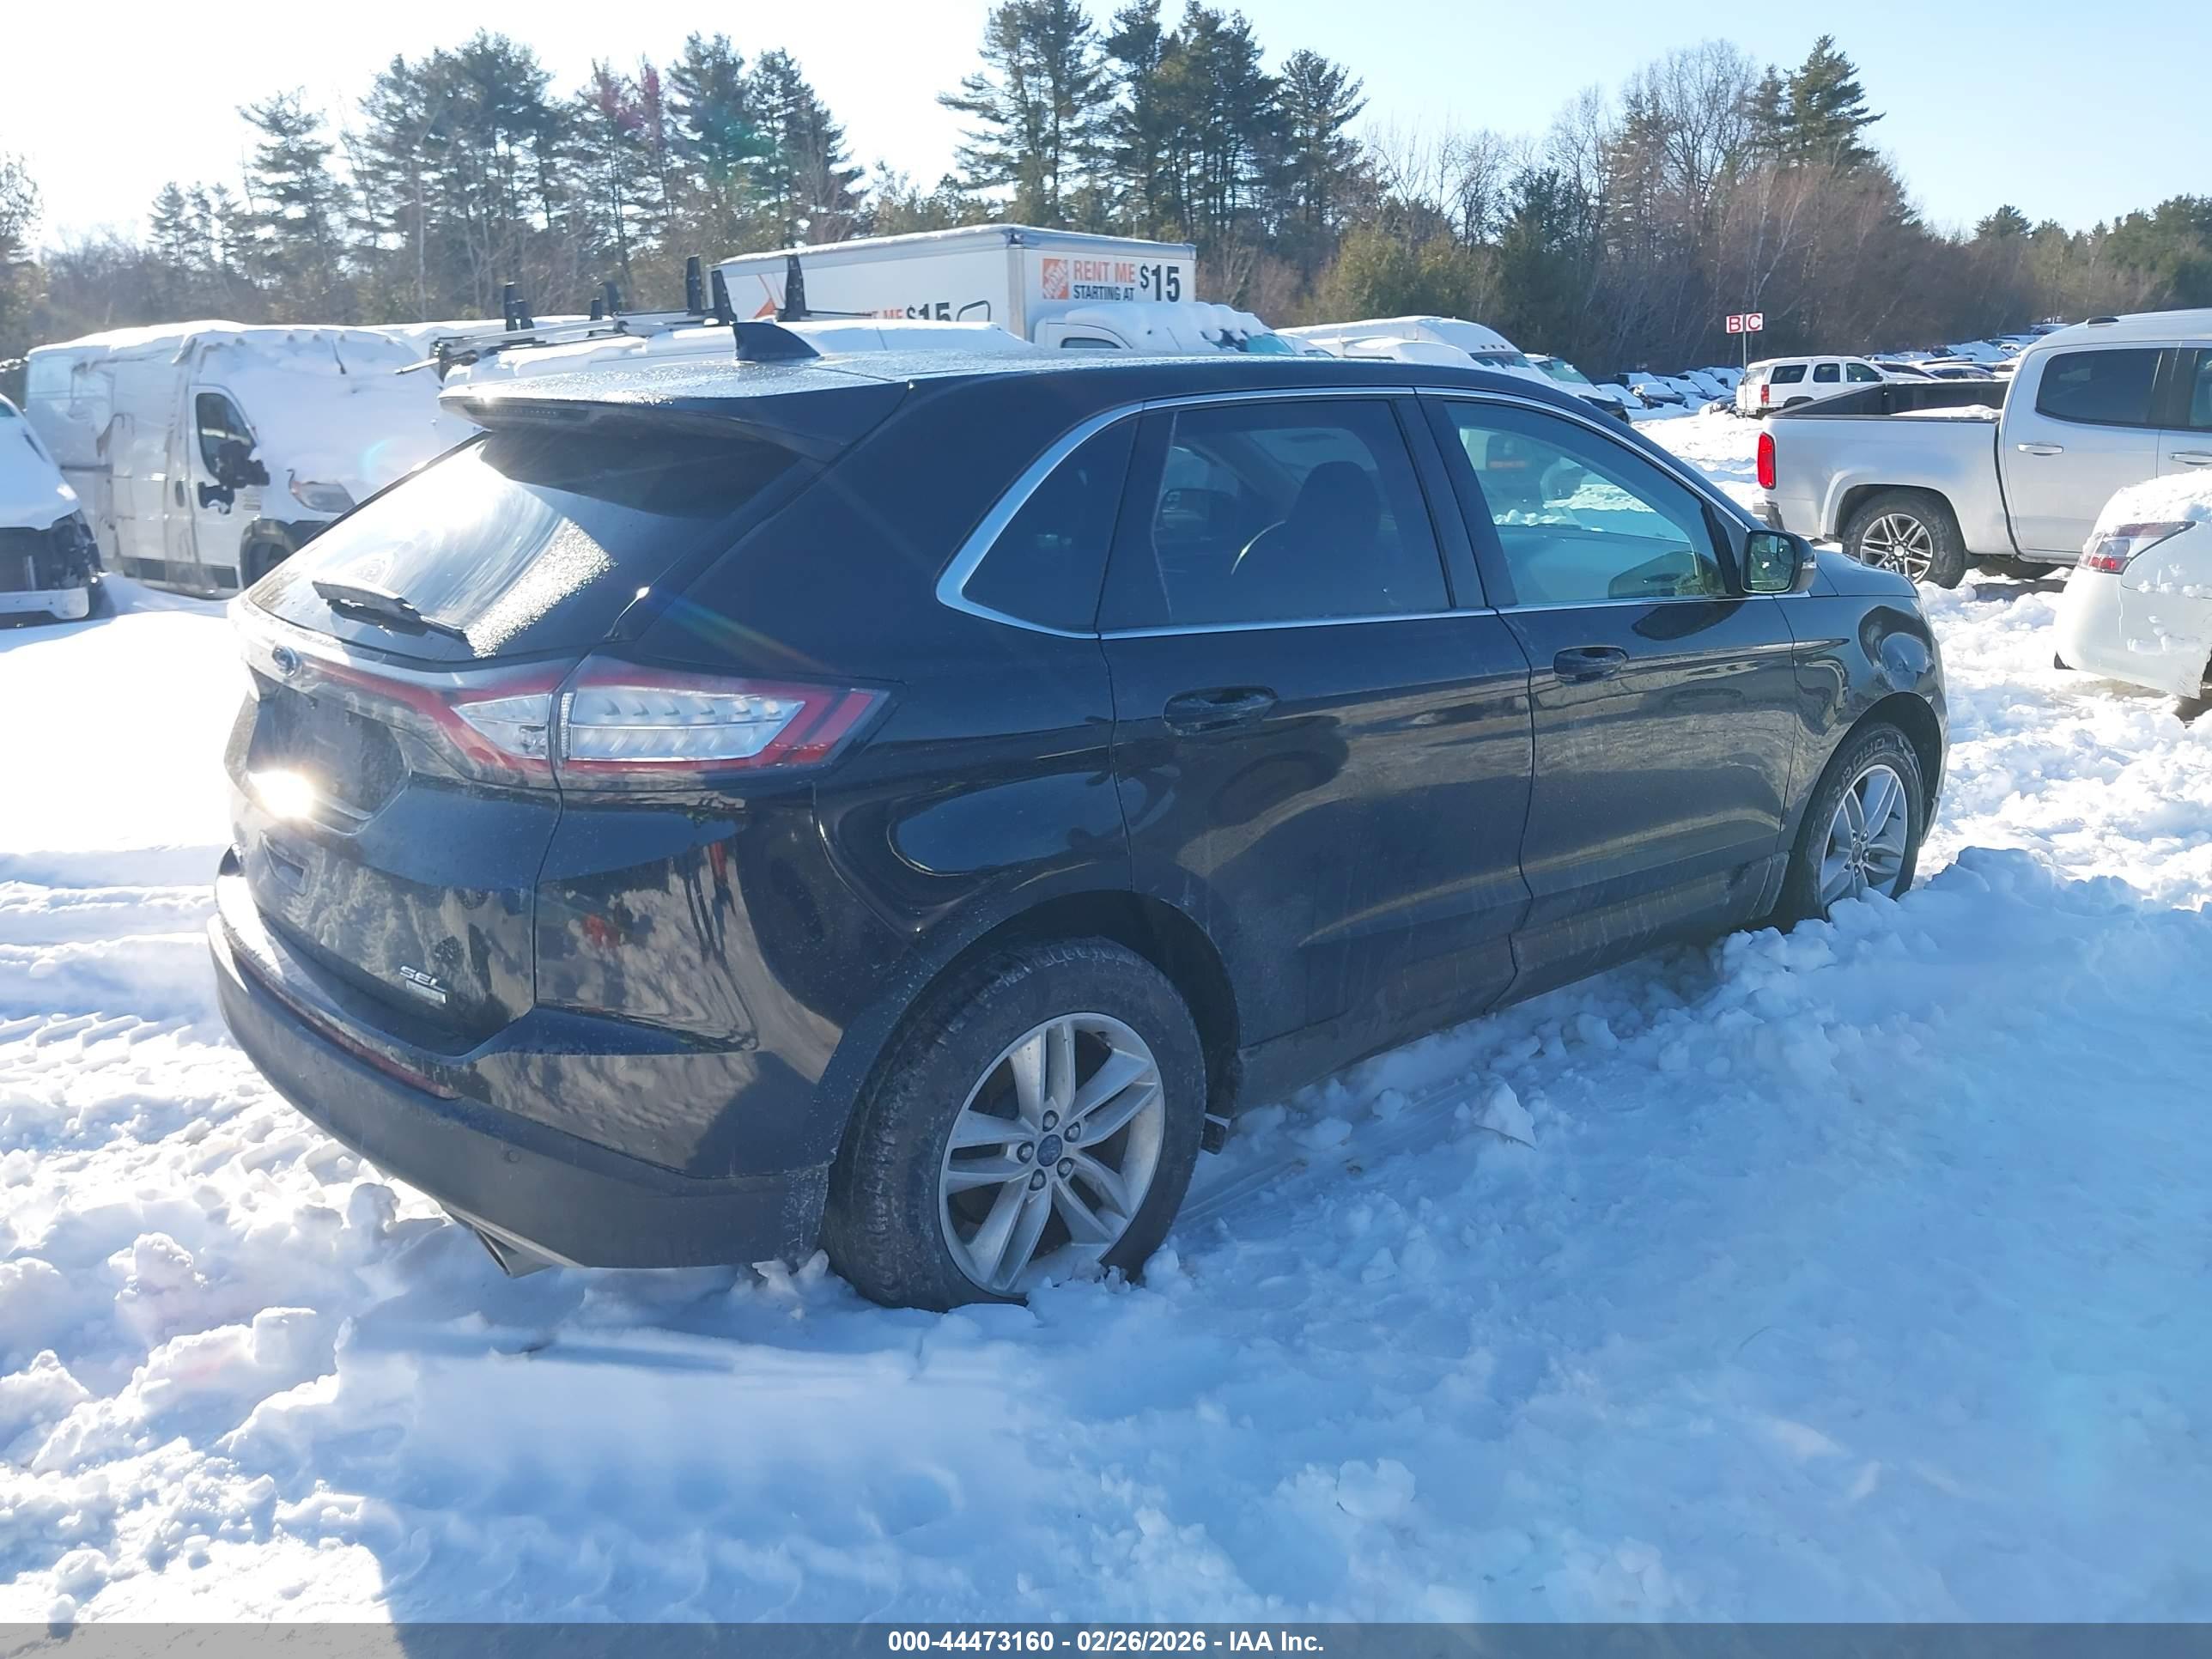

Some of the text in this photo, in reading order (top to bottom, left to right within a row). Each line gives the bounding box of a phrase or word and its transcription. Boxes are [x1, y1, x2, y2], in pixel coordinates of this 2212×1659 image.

[1074, 260, 1109, 282] RENT
[1115, 262, 1135, 283] ME
[1139, 263, 1180, 302] $15
[1074, 285, 1134, 301] STARTING AT
[1729, 314, 1760, 332] B C
[399, 965, 446, 993] SEL
